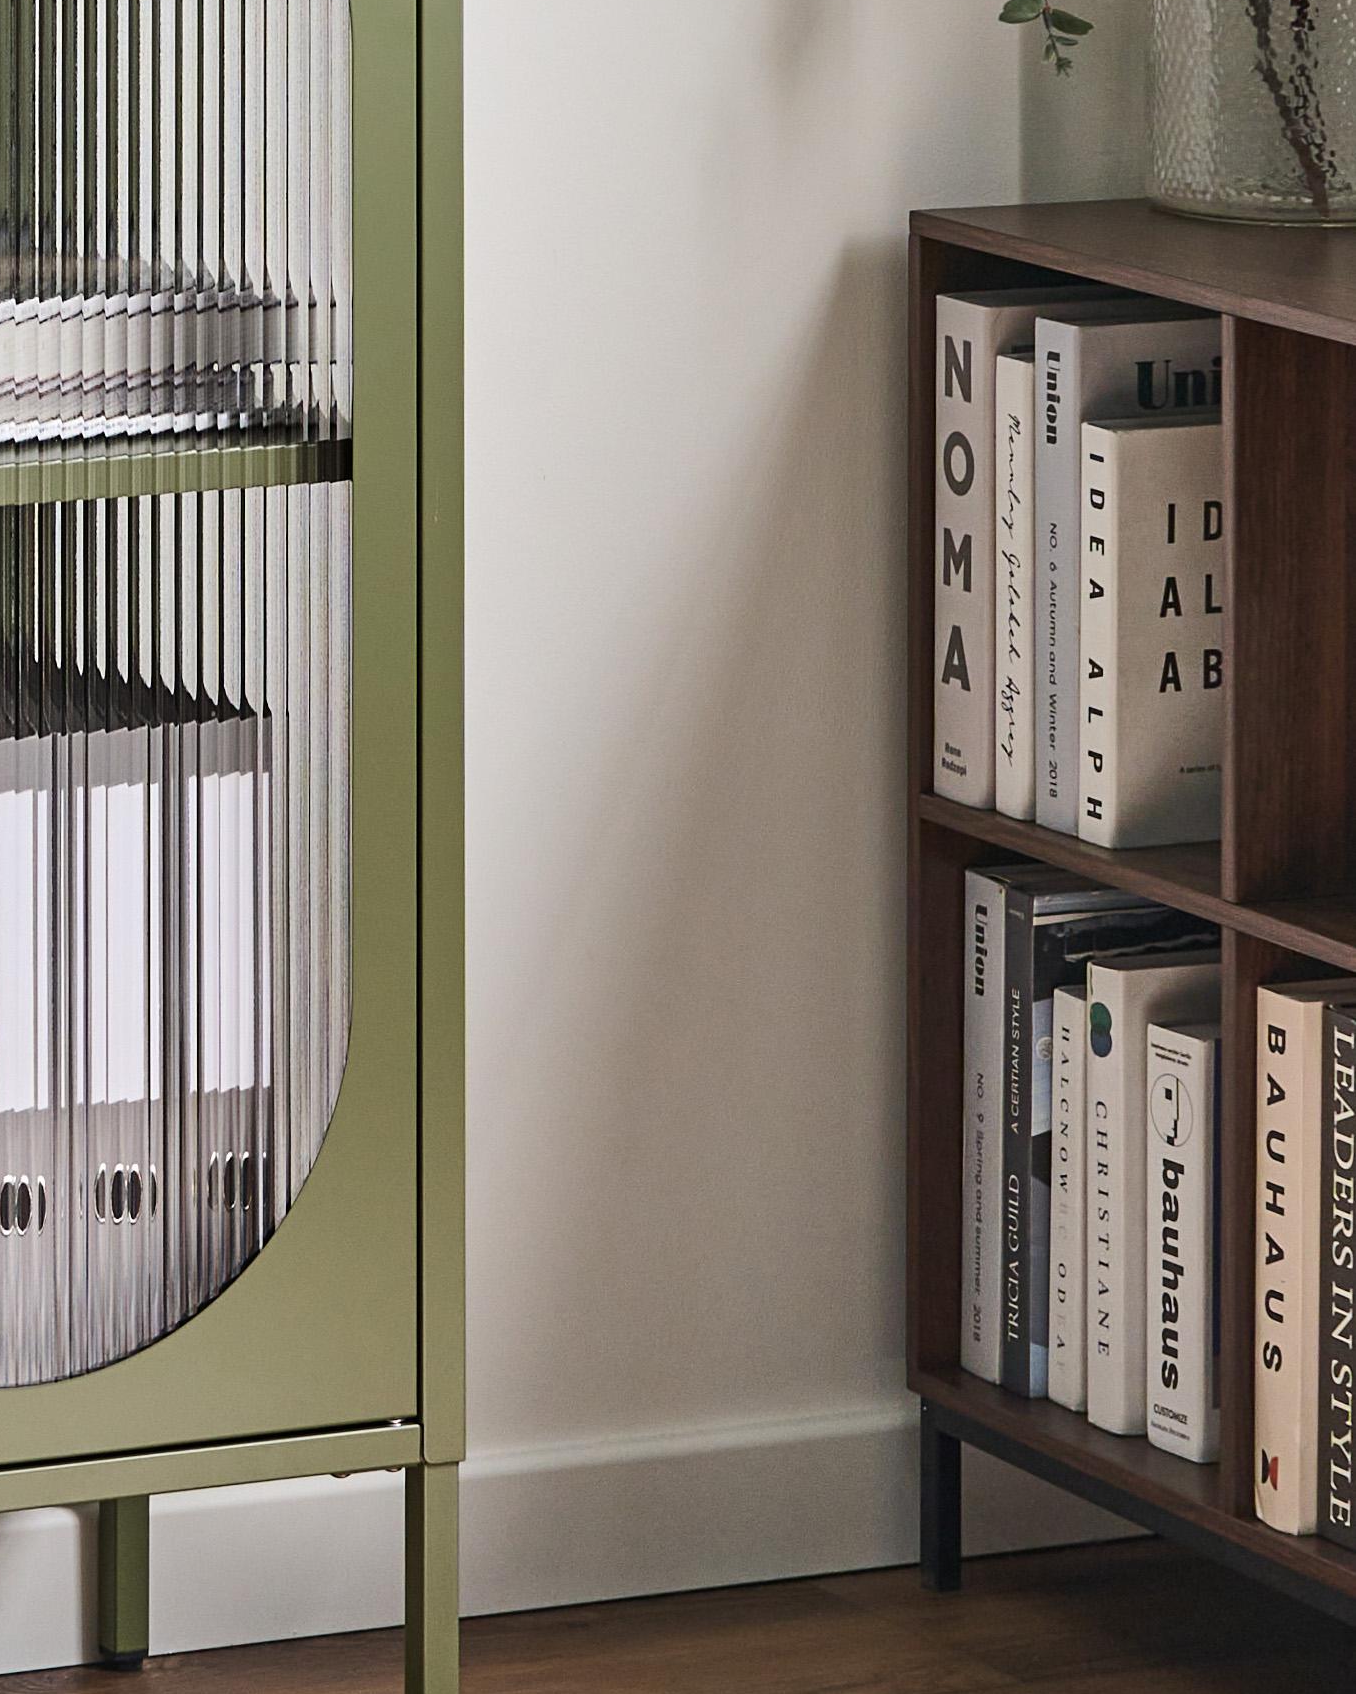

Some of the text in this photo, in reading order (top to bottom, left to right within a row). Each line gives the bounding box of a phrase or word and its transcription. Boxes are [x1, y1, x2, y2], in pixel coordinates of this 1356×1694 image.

[1046, 350, 1061, 445] Union
[942, 334, 975, 692] NOMA
[1049, 561, 1058, 573] 6
[1049, 580, 1058, 647] Autumn
[1086, 452, 1105, 821] IDEA ALPH
[1049, 651, 1058, 686] and
[1049, 693, 1058, 751] Winter
[1048, 759, 1058, 799] 2018
[974, 904, 988, 997] Union
[1011, 987, 1021, 1041] STYLE
[976, 1113, 985, 1124] 9
[1010, 1122, 1020, 1135] A
[974, 1189, 983, 1224] and
[1007, 1173, 1021, 1252] GUILD
[1095, 1099, 1110, 1357] CHRISTIANE
[1262, 1023, 1287, 1373] BAUHAUS
[1007, 1260, 1020, 1343] TRICIA
[1161, 1158, 1185, 1391] bauhaus
[1329, 1024, 1356, 1529] LEADERS IN STYLE
[972, 1302, 982, 1343] 2018
